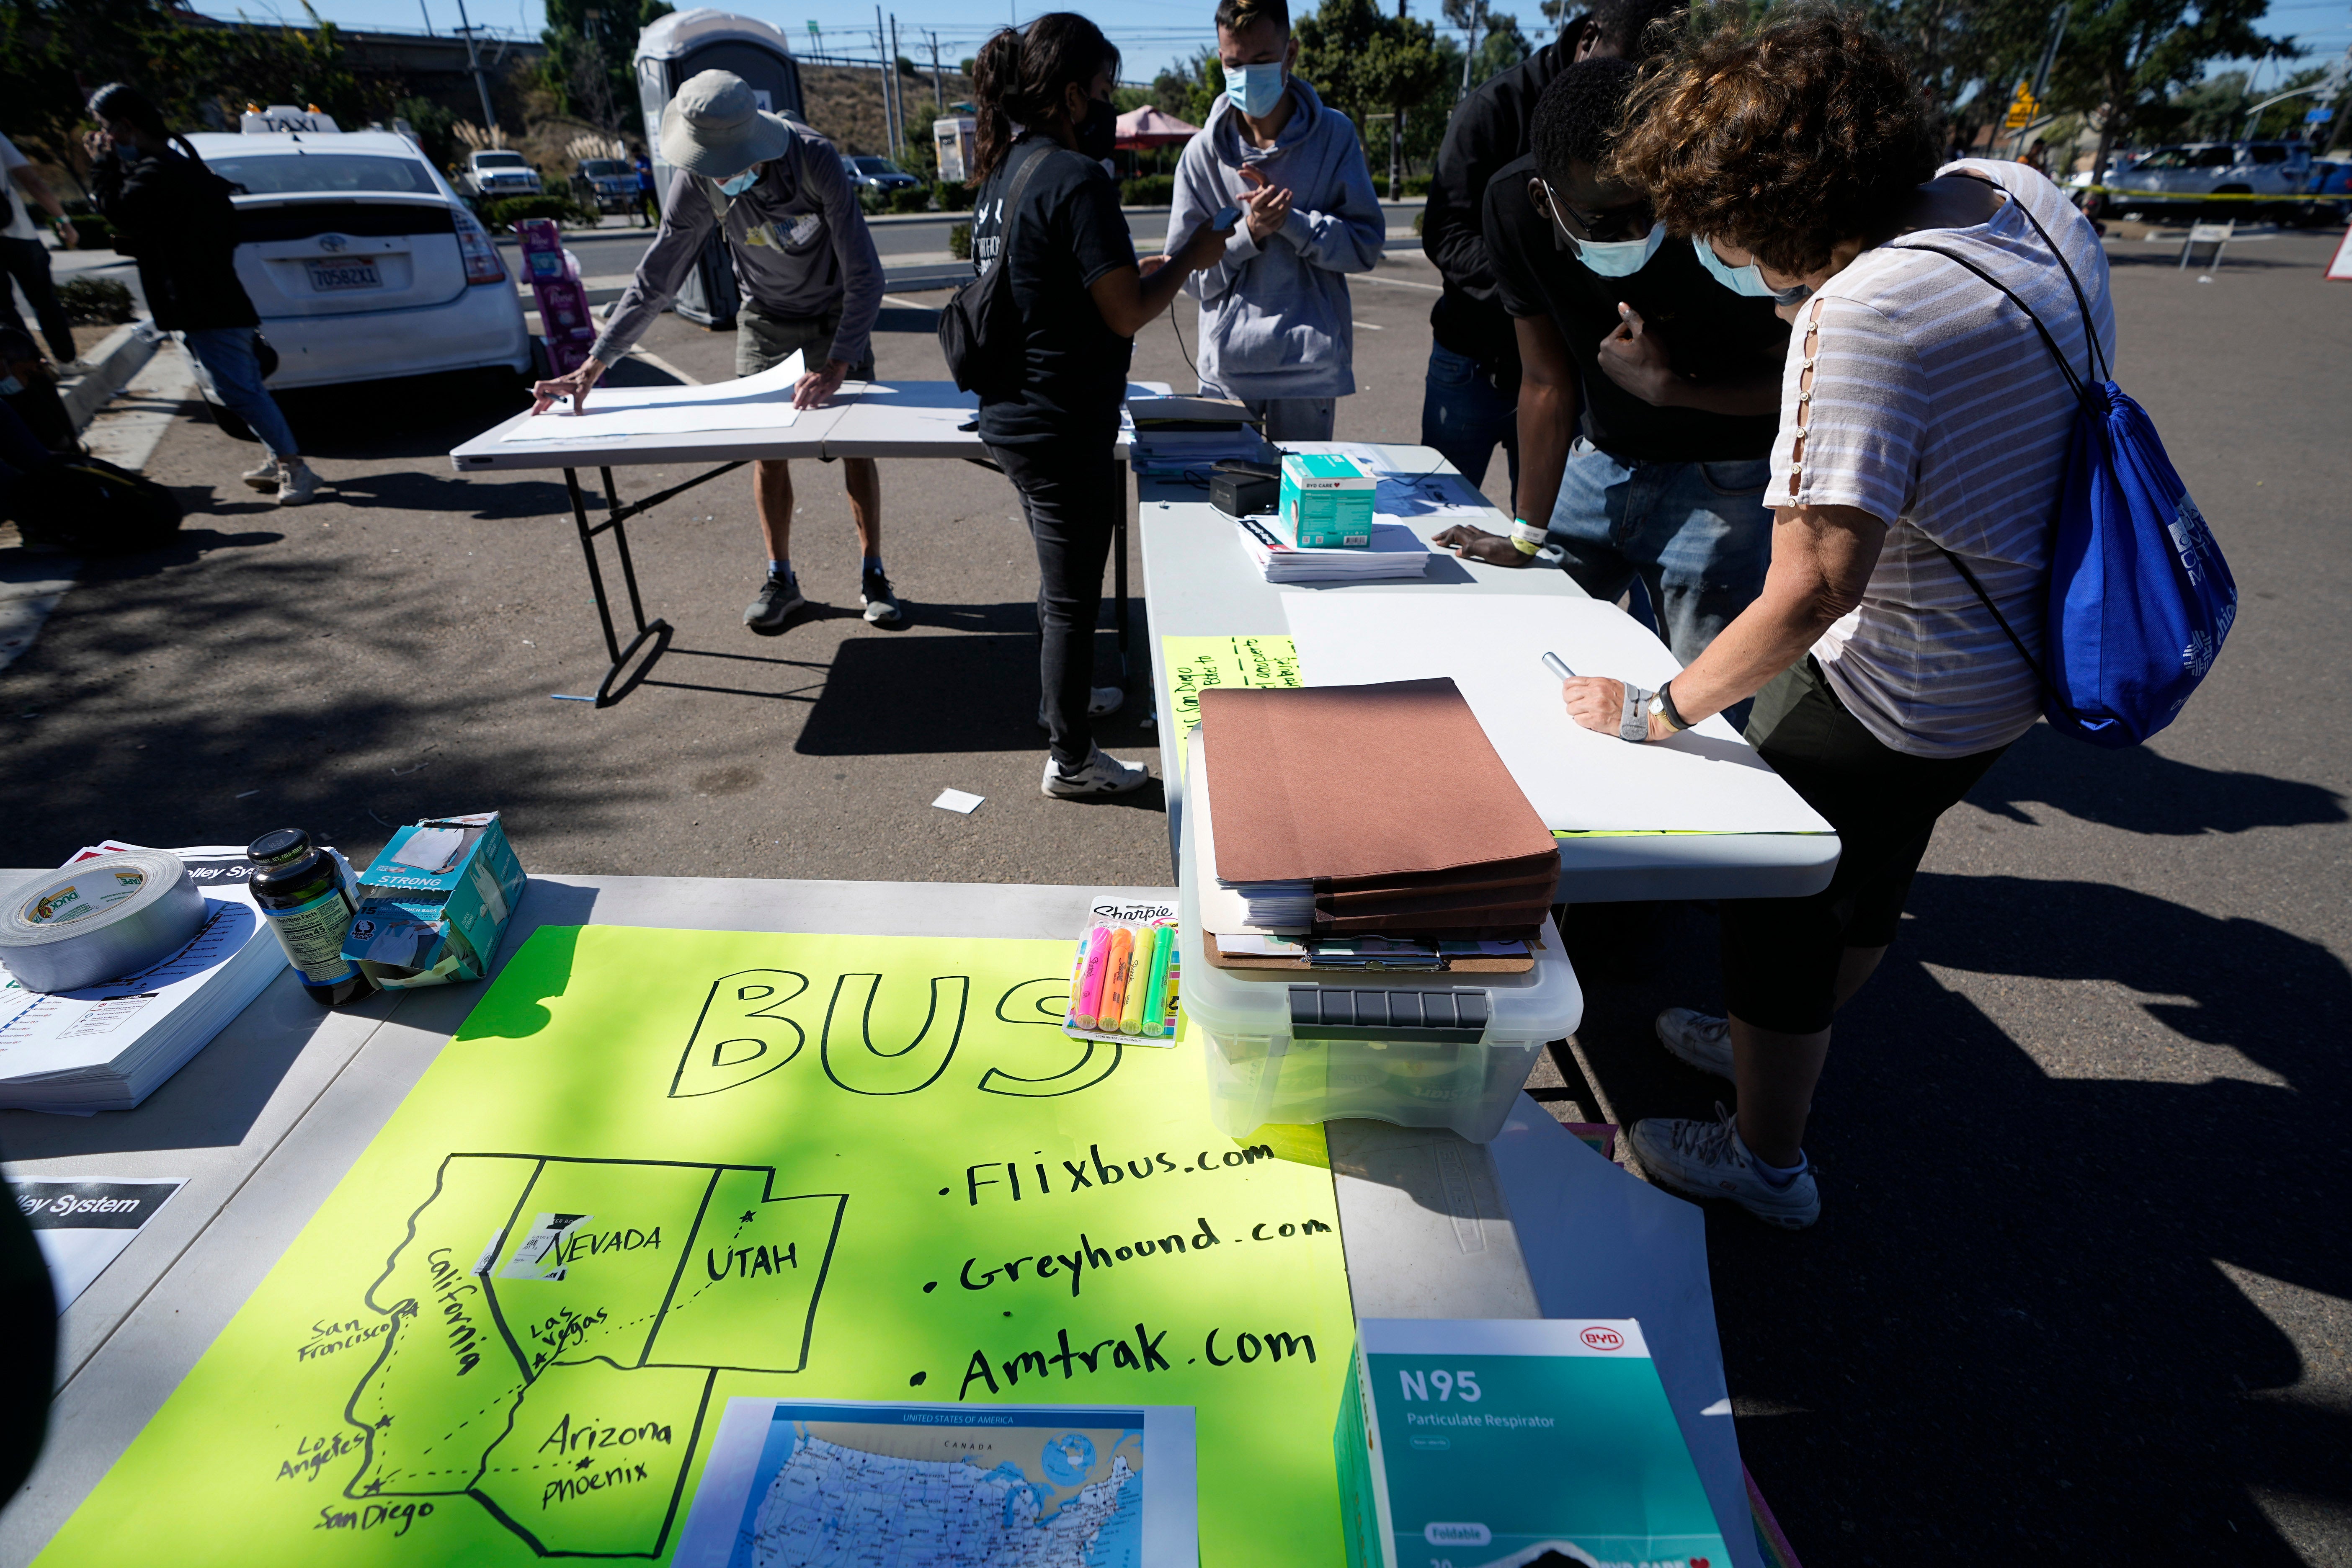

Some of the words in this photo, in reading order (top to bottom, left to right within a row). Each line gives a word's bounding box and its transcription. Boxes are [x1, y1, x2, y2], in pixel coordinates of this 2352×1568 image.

[260, 118, 319, 132] TAXI
[1174, 667, 1207, 693] Diego
[1176, 696, 1201, 713] San
[281, 844, 304, 859] COLD-BREW!
[188, 867, 226, 879] olley
[226, 866, 255, 878] Sys
[377, 875, 442, 887] STRONG
[38, 898, 48, 909] DUCK
[49, 891, 79, 911] DUCK
[33, 913, 44, 923] TA
[276, 915, 301, 923] Nutrition
[302, 910, 317, 919] Facts
[461, 912, 470, 926] SUPER
[465, 914, 474, 930] STRONG
[1094, 905, 1173, 921] Sharpie
[286, 932, 313, 941] Calories
[314, 926, 326, 934] 45
[1086, 956, 1099, 980] Sharpie
[1117, 957, 1128, 982] Sharpie
[1129, 959, 1139, 985] Sharpie
[668, 968, 1123, 1098] BUS
[966, 1142, 1275, 1206] Flixbus.com
[15, 1194, 53, 1216] lley
[49, 1194, 140, 1217] System
[534, 1226, 661, 1267] NEVADA
[707, 1244, 798, 1283] UTAH
[426, 1247, 481, 1377] California
[530, 1306, 573, 1338] Las
[311, 1318, 361, 1342] San
[1586, 1332, 1620, 1345] BYD
[297, 1321, 392, 1364] Francisco
[1399, 1369, 1483, 1403] N95
[1359, 1380, 1370, 1425] CARE
[903, 1413, 933, 1423] UNITED
[934, 1414, 963, 1424] STATES
[965, 1415, 975, 1424] OF
[977, 1416, 1014, 1424] AMERICA
[1407, 1412, 1483, 1428] Particulate
[1484, 1413, 1556, 1431] Respirator
[537, 1414, 672, 1455] Arizona
[276, 1431, 367, 1482] Angeles
[944, 1441, 993, 1451] CANADA
[313, 1505, 358, 1531] San
[358, 1500, 435, 1537] Diego
[1431, 1528, 1482, 1541] Foldable
